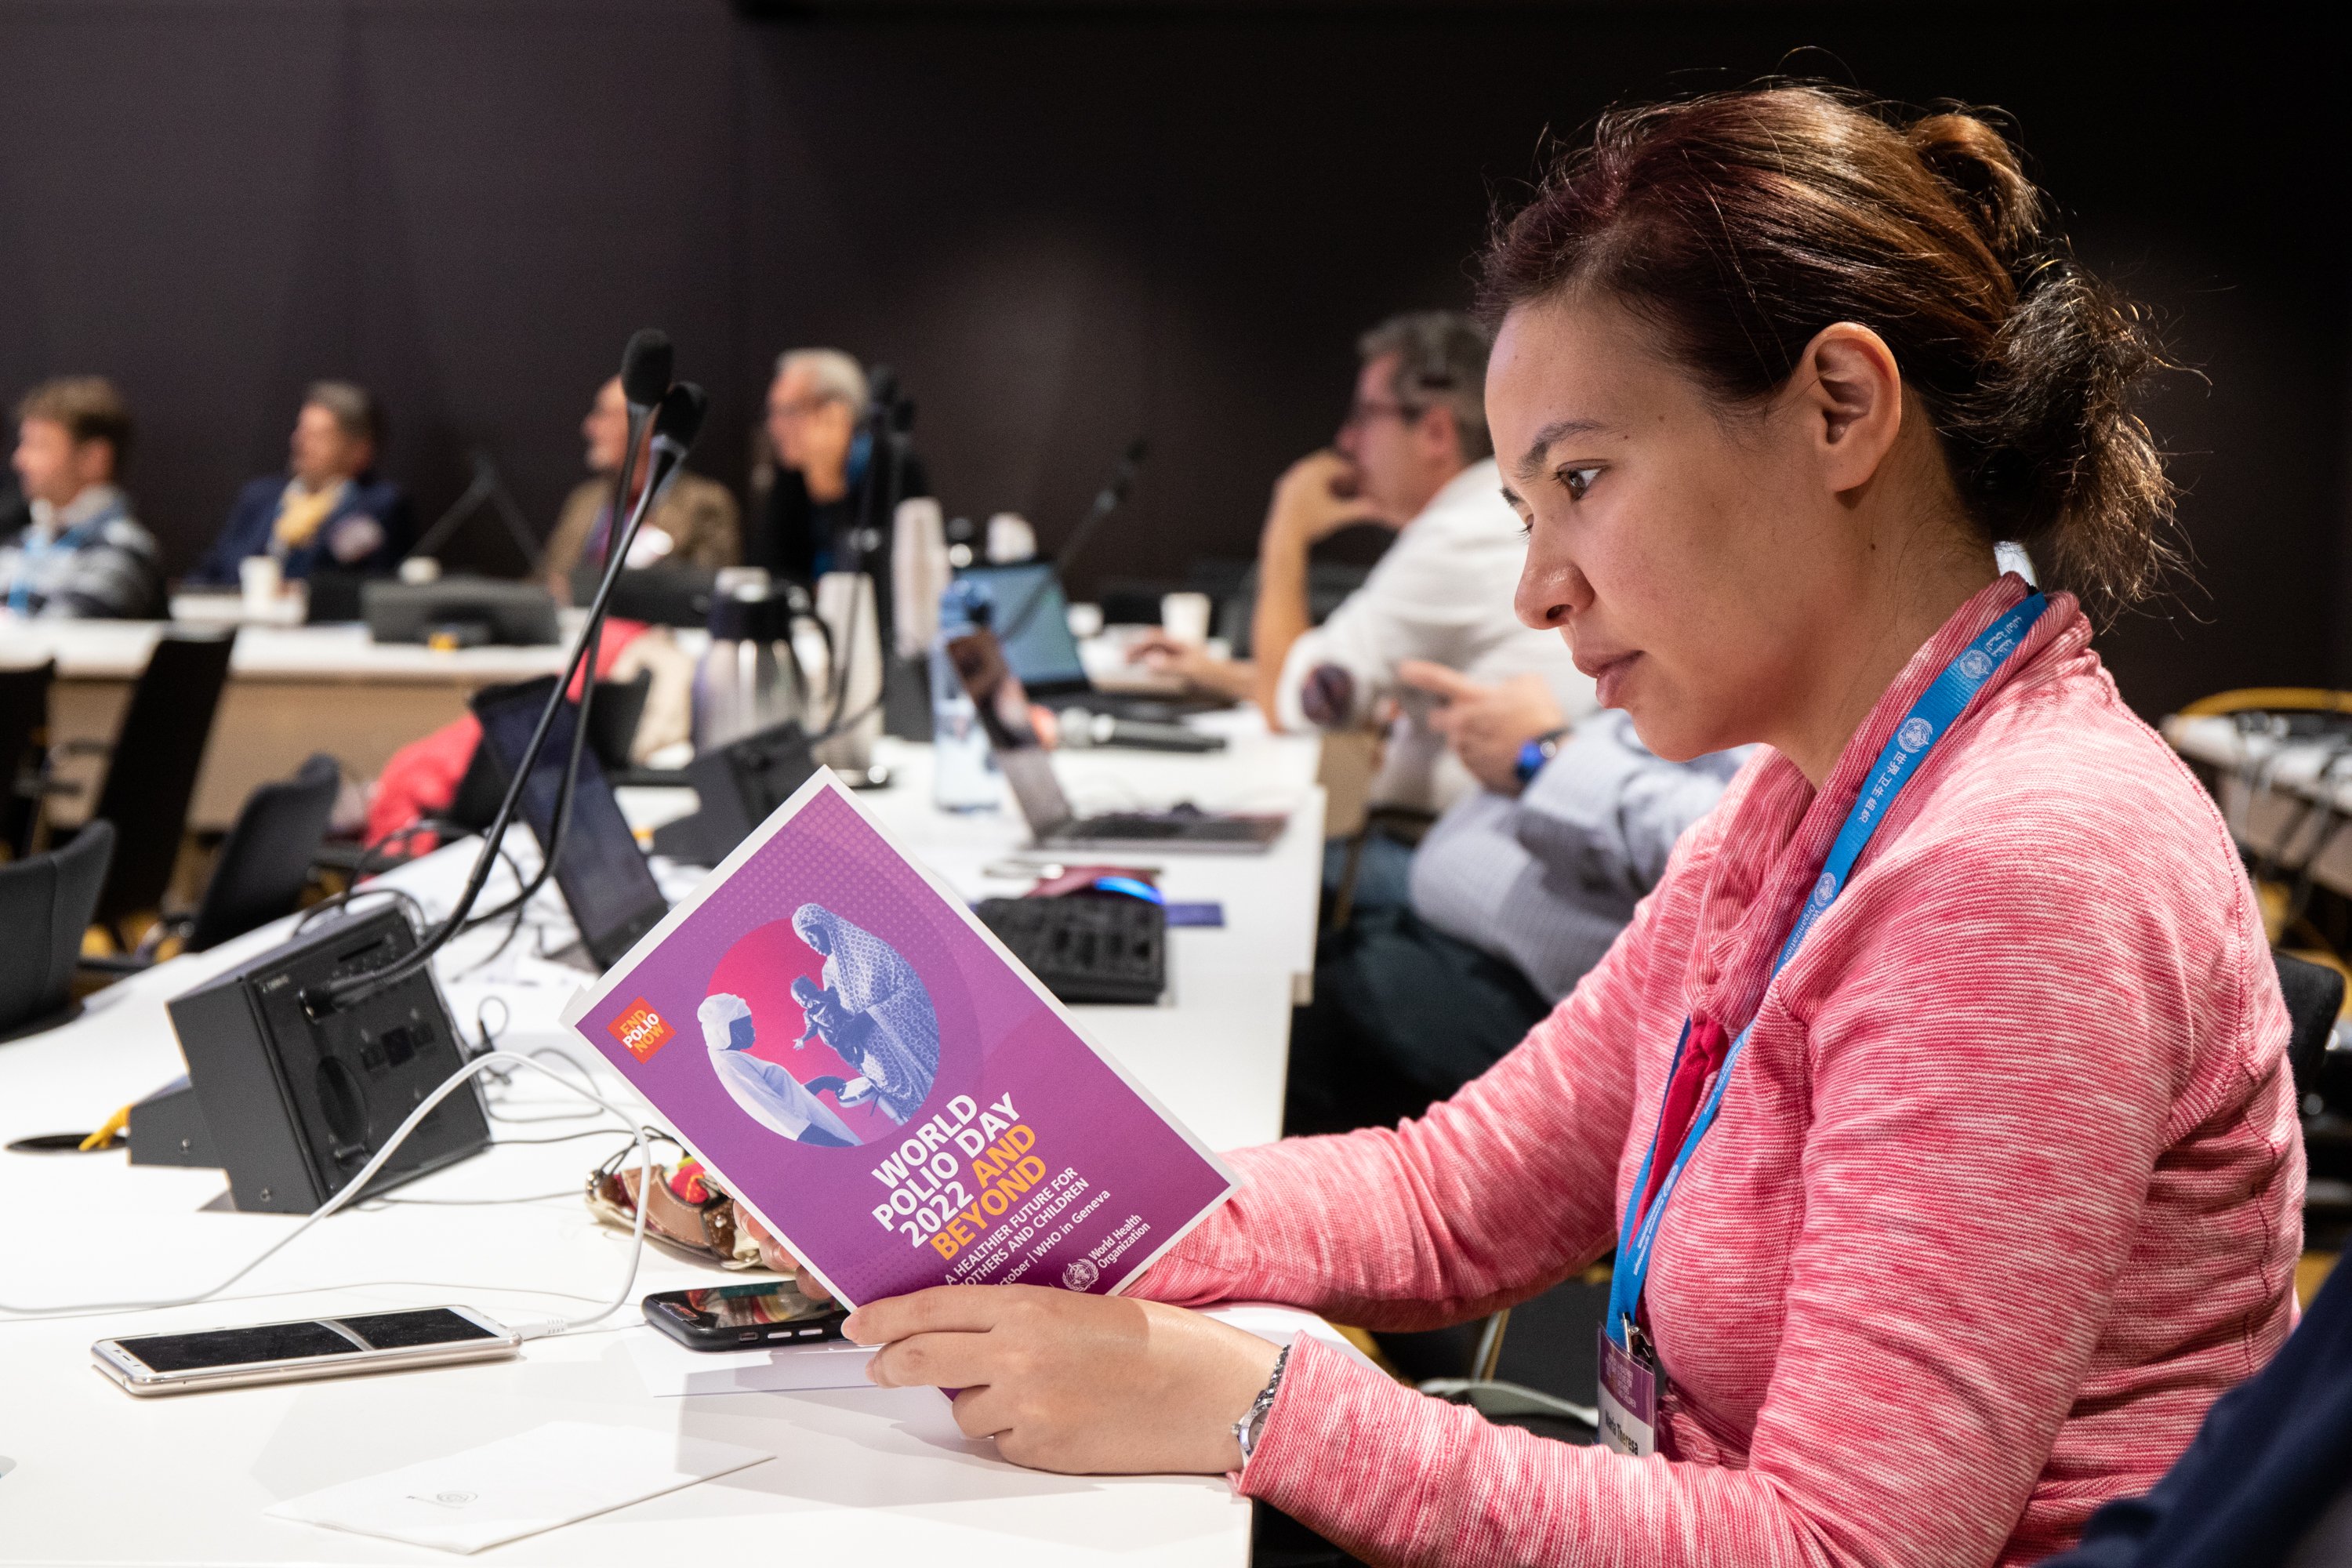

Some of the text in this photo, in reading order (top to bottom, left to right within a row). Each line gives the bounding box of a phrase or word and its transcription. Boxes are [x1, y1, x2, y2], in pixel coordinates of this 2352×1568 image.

[1858, 750, 1907, 824] 世界卫生组织
[1784, 903, 1816, 962] Organization
[619, 1009, 647, 1036] END
[622, 1013, 659, 1049] POLIO
[633, 1023, 665, 1054] NOW
[871, 1094, 978, 1189] WORLD
[871, 1091, 1020, 1232] POLIO DAY
[899, 1124, 1036, 1248] 2022 AND
[930, 1156, 1046, 1261] BEYOND
[945, 1167, 1078, 1286] A HEALTHIER FUTURE FOR
[959, 1178, 1090, 1286] OTHERS AND CHILDREN
[993, 1259, 1031, 1286] ctober
[1033, 1232, 1062, 1258] WHO
[1061, 1222, 1074, 1236] in
[1071, 1189, 1111, 1224] Geneva
[1087, 1214, 1142, 1261] World Health
[1098, 1221, 1151, 1269] Organization
